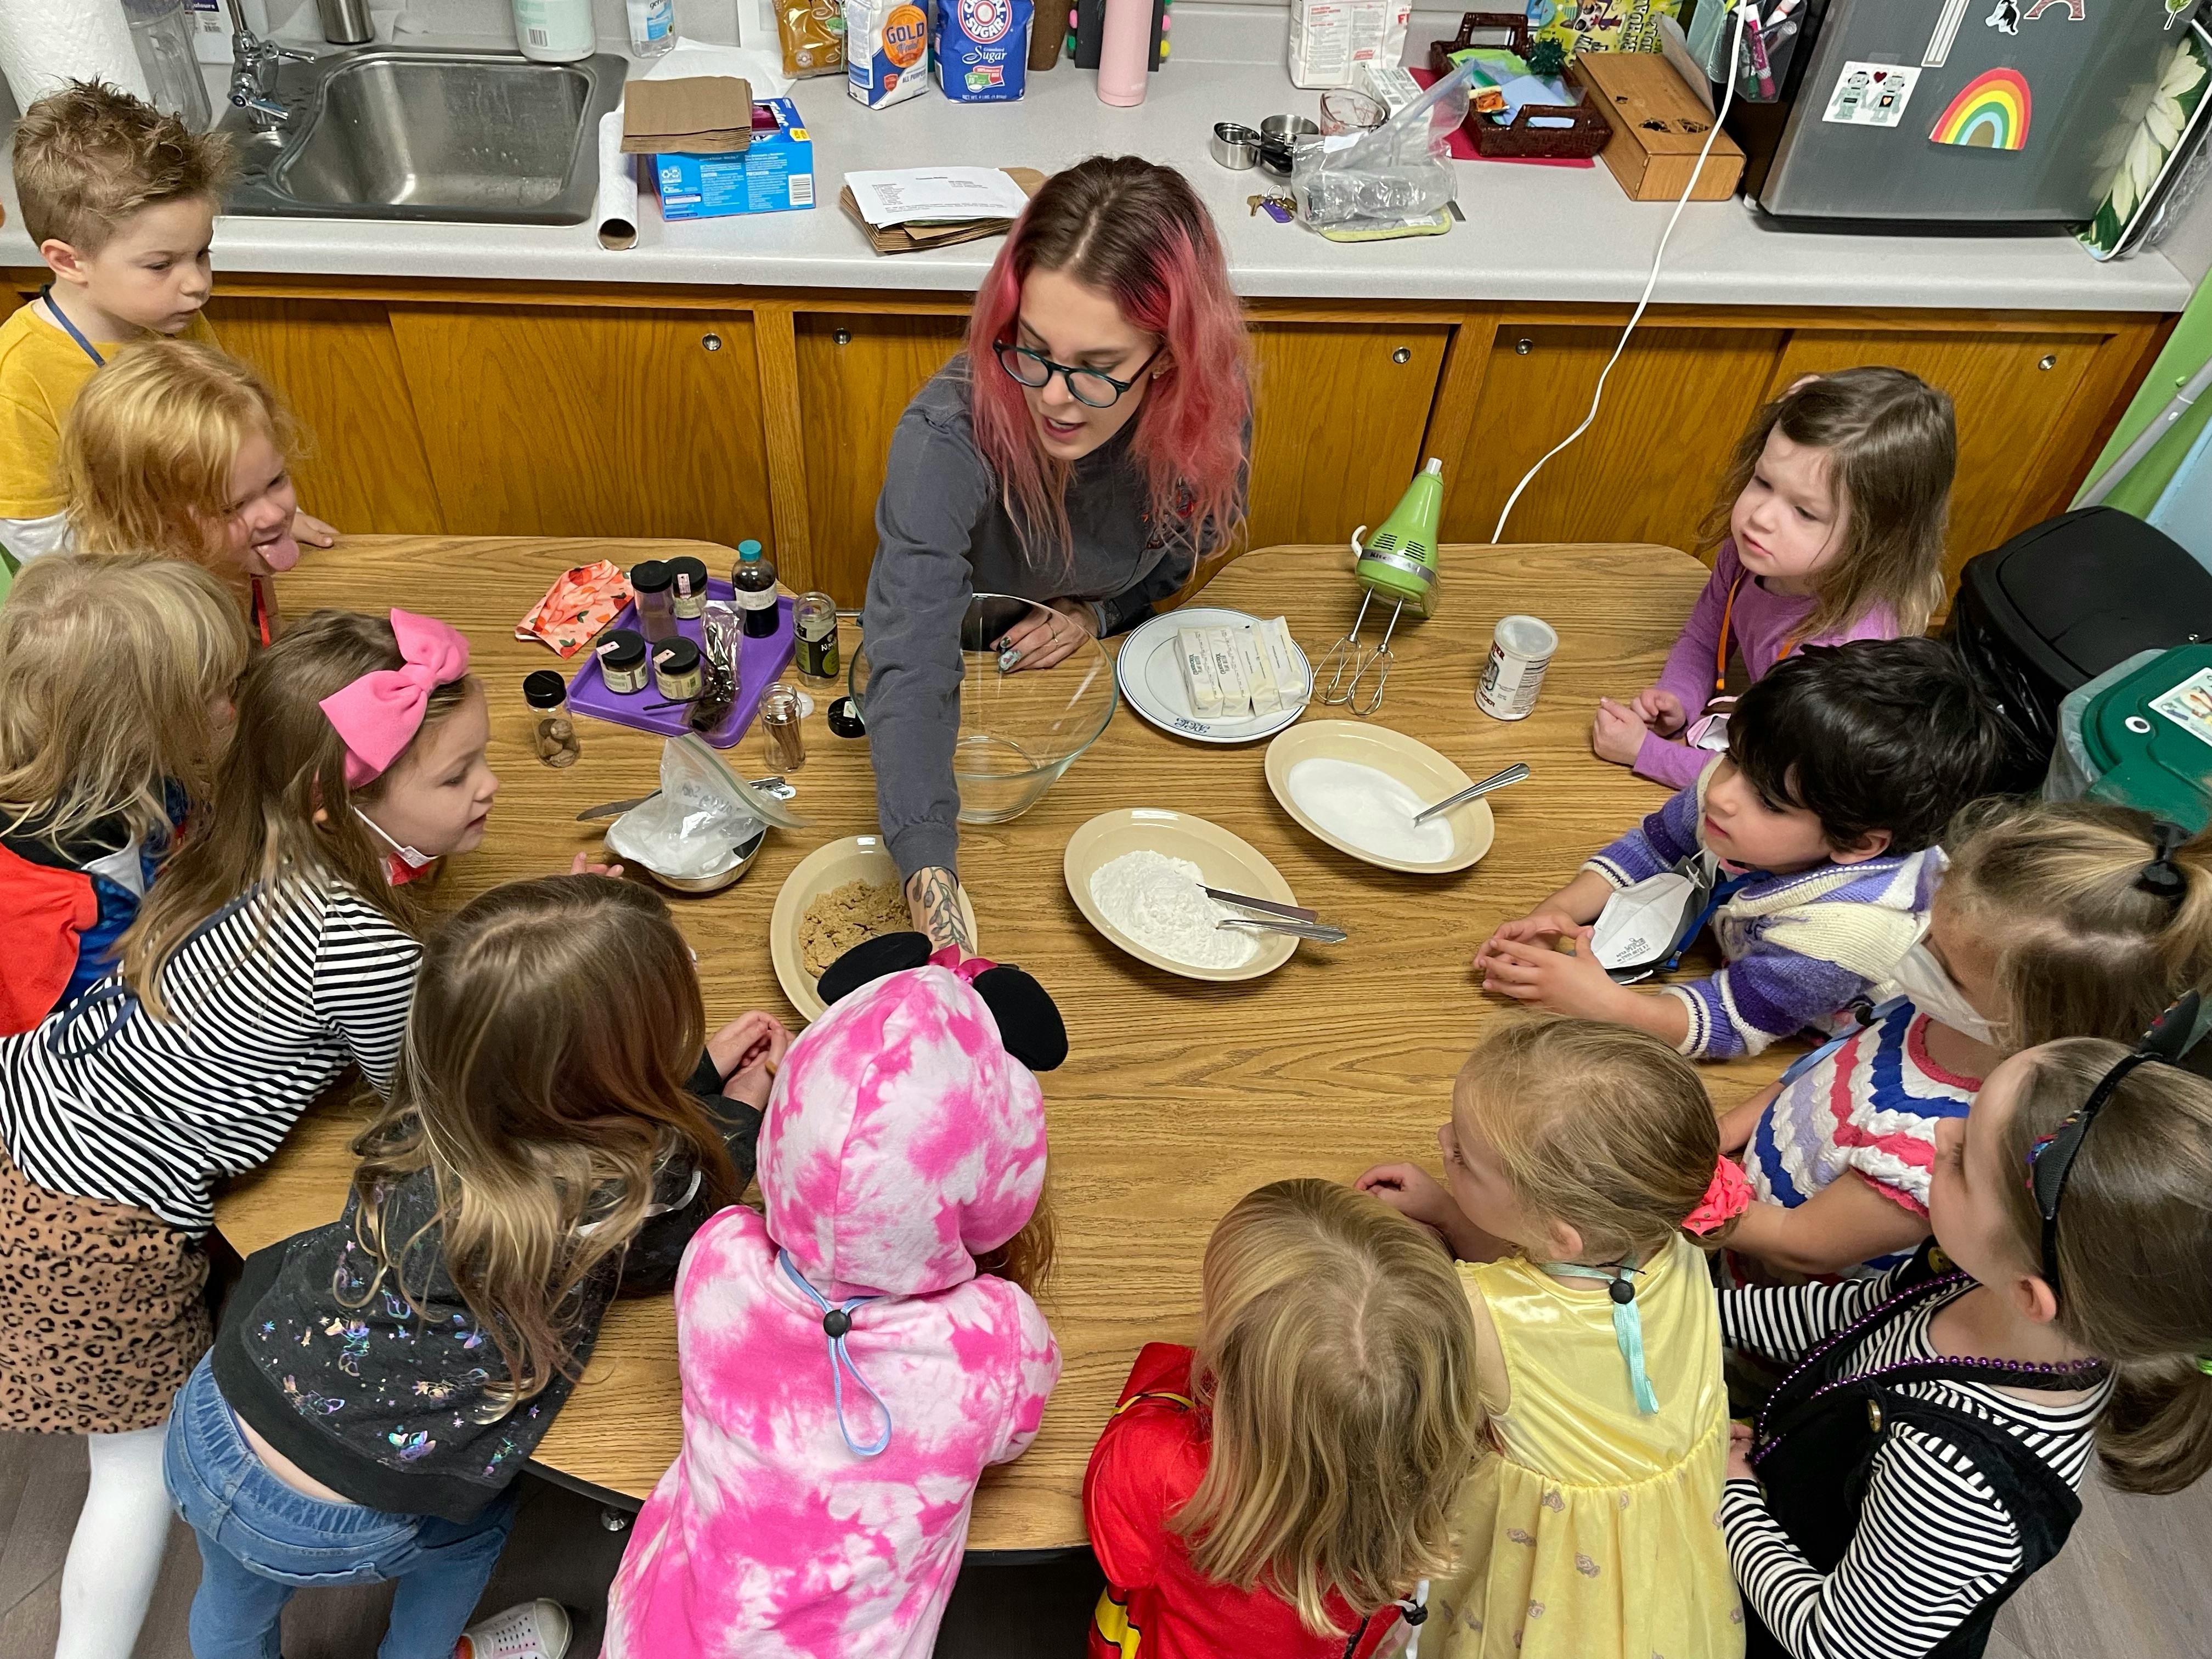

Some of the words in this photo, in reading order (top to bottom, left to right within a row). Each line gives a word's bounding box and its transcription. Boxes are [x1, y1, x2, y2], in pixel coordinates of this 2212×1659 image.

[887, 22, 924, 44] GOLD
[966, 17, 1005, 38] SUGAR
[962, 46, 1007, 64] Sugar
